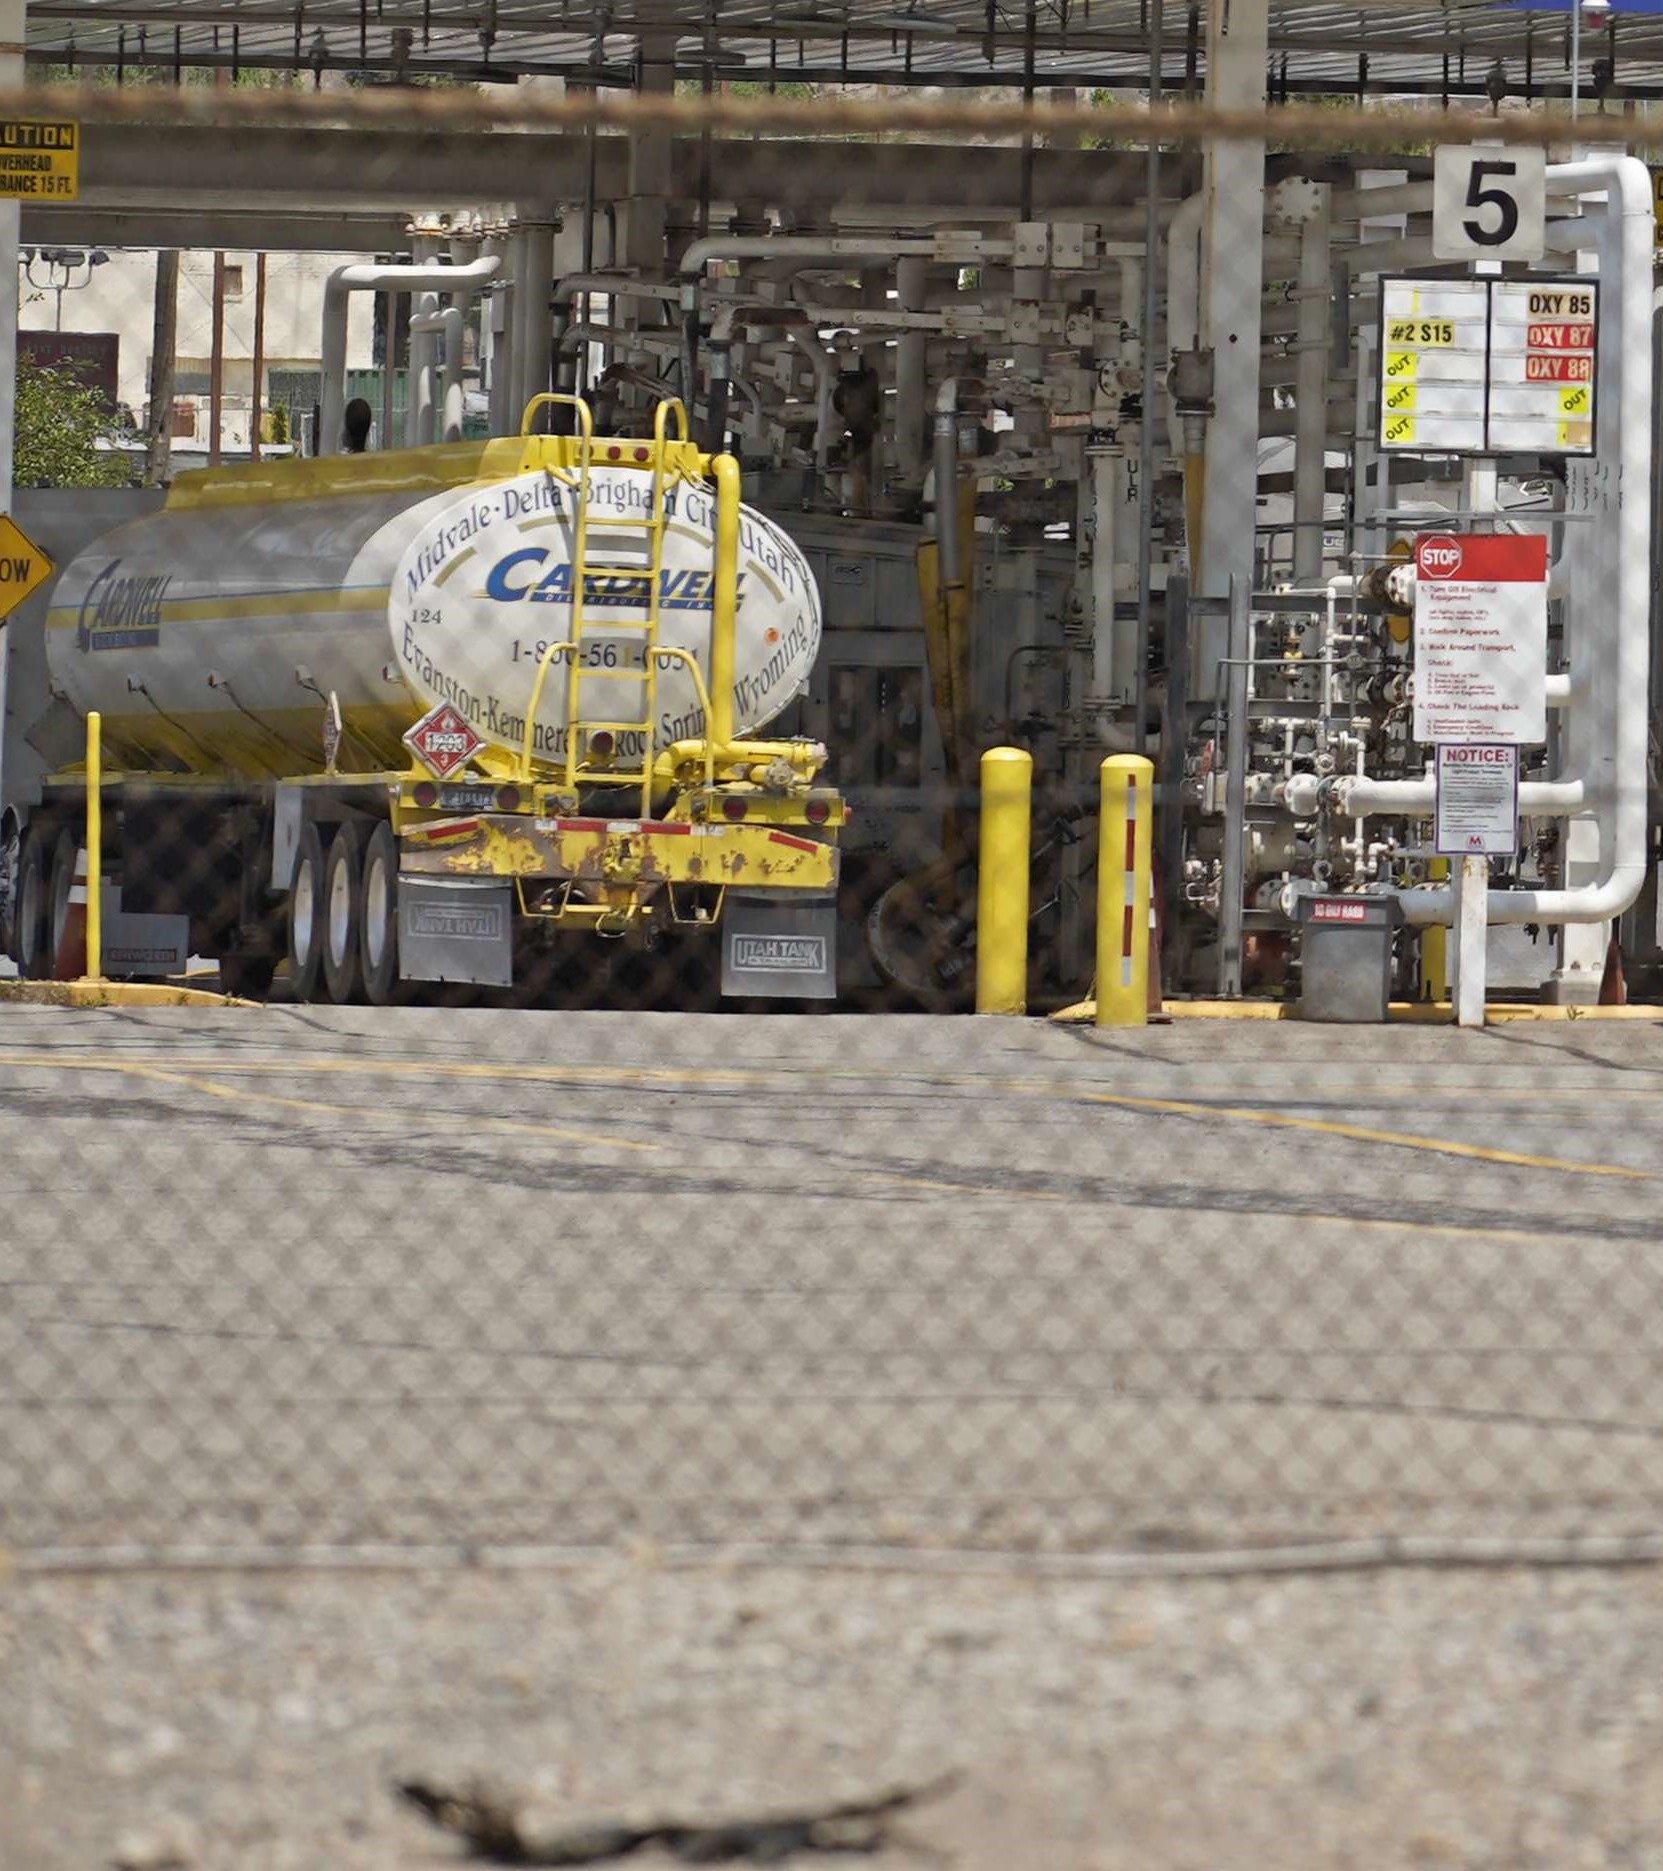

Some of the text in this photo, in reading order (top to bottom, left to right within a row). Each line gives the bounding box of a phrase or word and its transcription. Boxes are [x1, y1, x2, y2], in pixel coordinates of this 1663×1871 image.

[0, 127, 73, 146] UTION
[41, 178, 54, 193] 15
[1463, 161, 1518, 246] 5
[1529, 294, 1590, 315] OXY 85
[1389, 324, 1452, 342] #2 S15
[1530, 327, 1592, 347] OXY 87
[1387, 354, 1411, 377] OUT
[1527, 358, 1590, 380] OXY 88
[1386, 386, 1411, 409] OUT
[1563, 388, 1587, 411] OUT
[1385, 418, 1410, 441] OUT
[405, 503, 491, 605] Midvale
[503, 479, 562, 521] Delta
[739, 514, 796, 594] Utah
[1423, 549, 1460, 566] STOP
[412, 609, 442, 624] 124
[403, 620, 481, 724] Evanston
[733, 614, 805, 717] Wyoming
[428, 734, 466, 751] 1203
[440, 753, 449, 767] 3
[1446, 749, 1509, 762] NOTICE:
[737, 940, 819, 968] UTAH TANK
